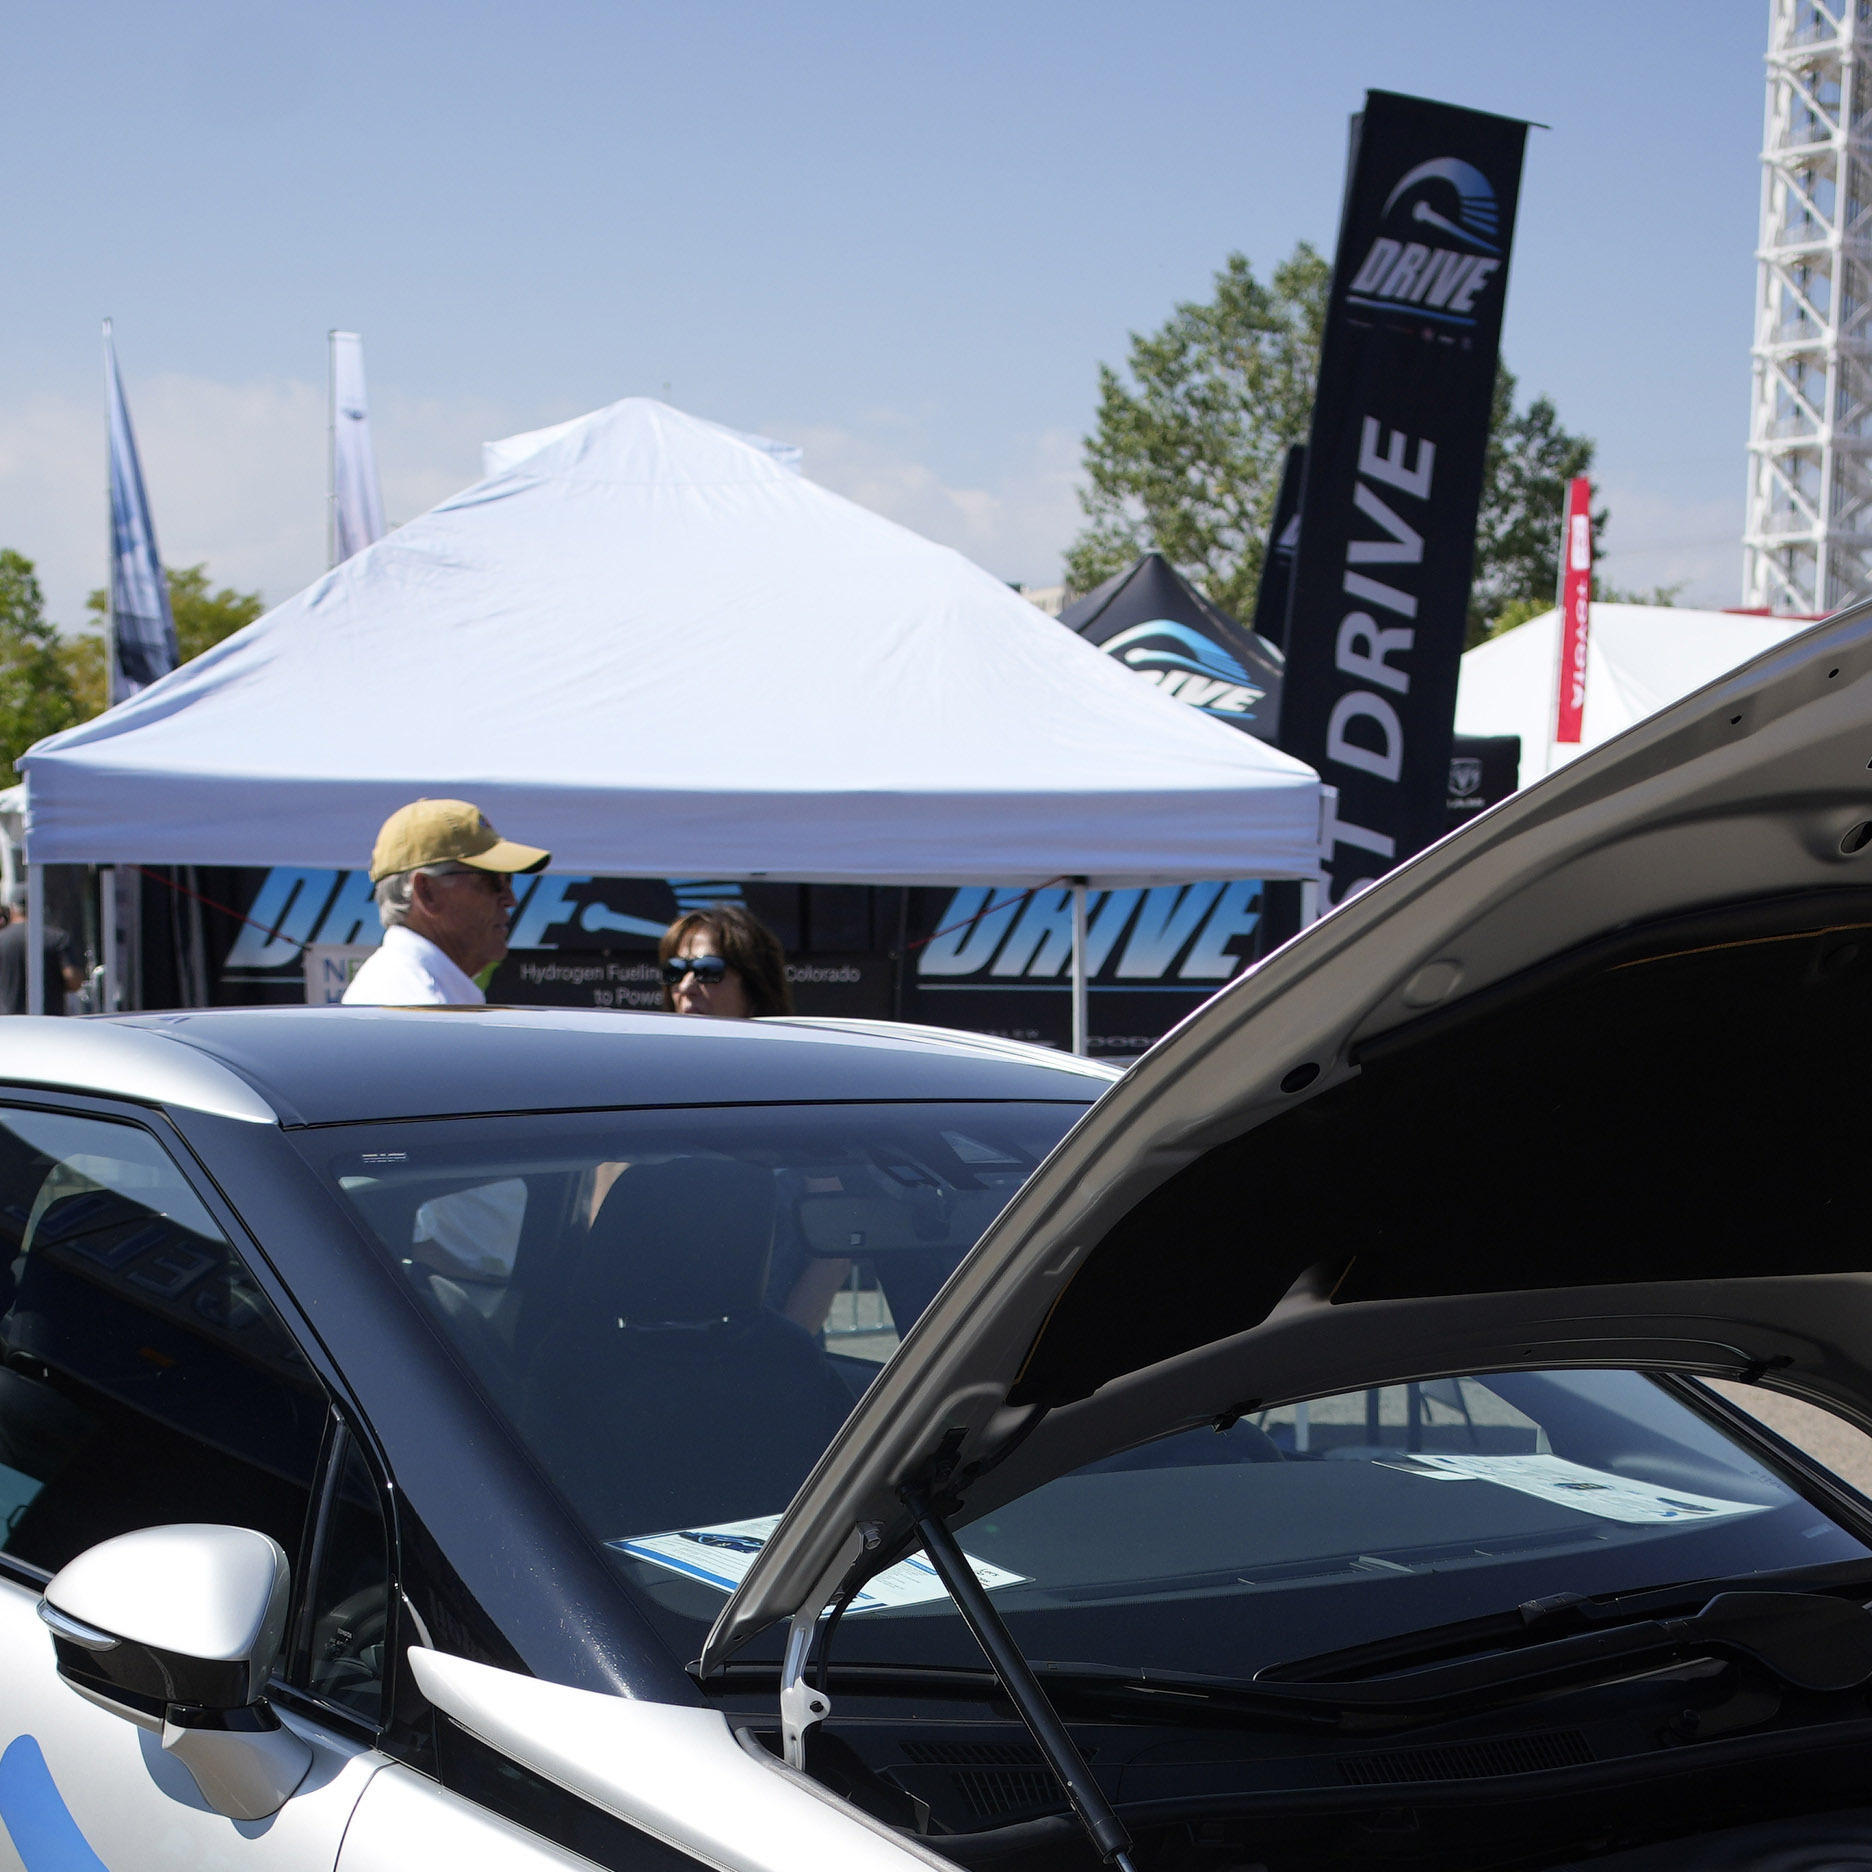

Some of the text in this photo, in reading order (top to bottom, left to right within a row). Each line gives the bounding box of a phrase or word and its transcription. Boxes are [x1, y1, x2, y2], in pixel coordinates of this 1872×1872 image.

[1347, 237, 1502, 315] DRIVE
[1328, 415, 1437, 783] DRIVE
[916, 879, 1264, 978] DRIVE
[520, 963, 861, 987] Hydrogen Fuelin Colorado
[593, 988, 665, 1007] to Powe
